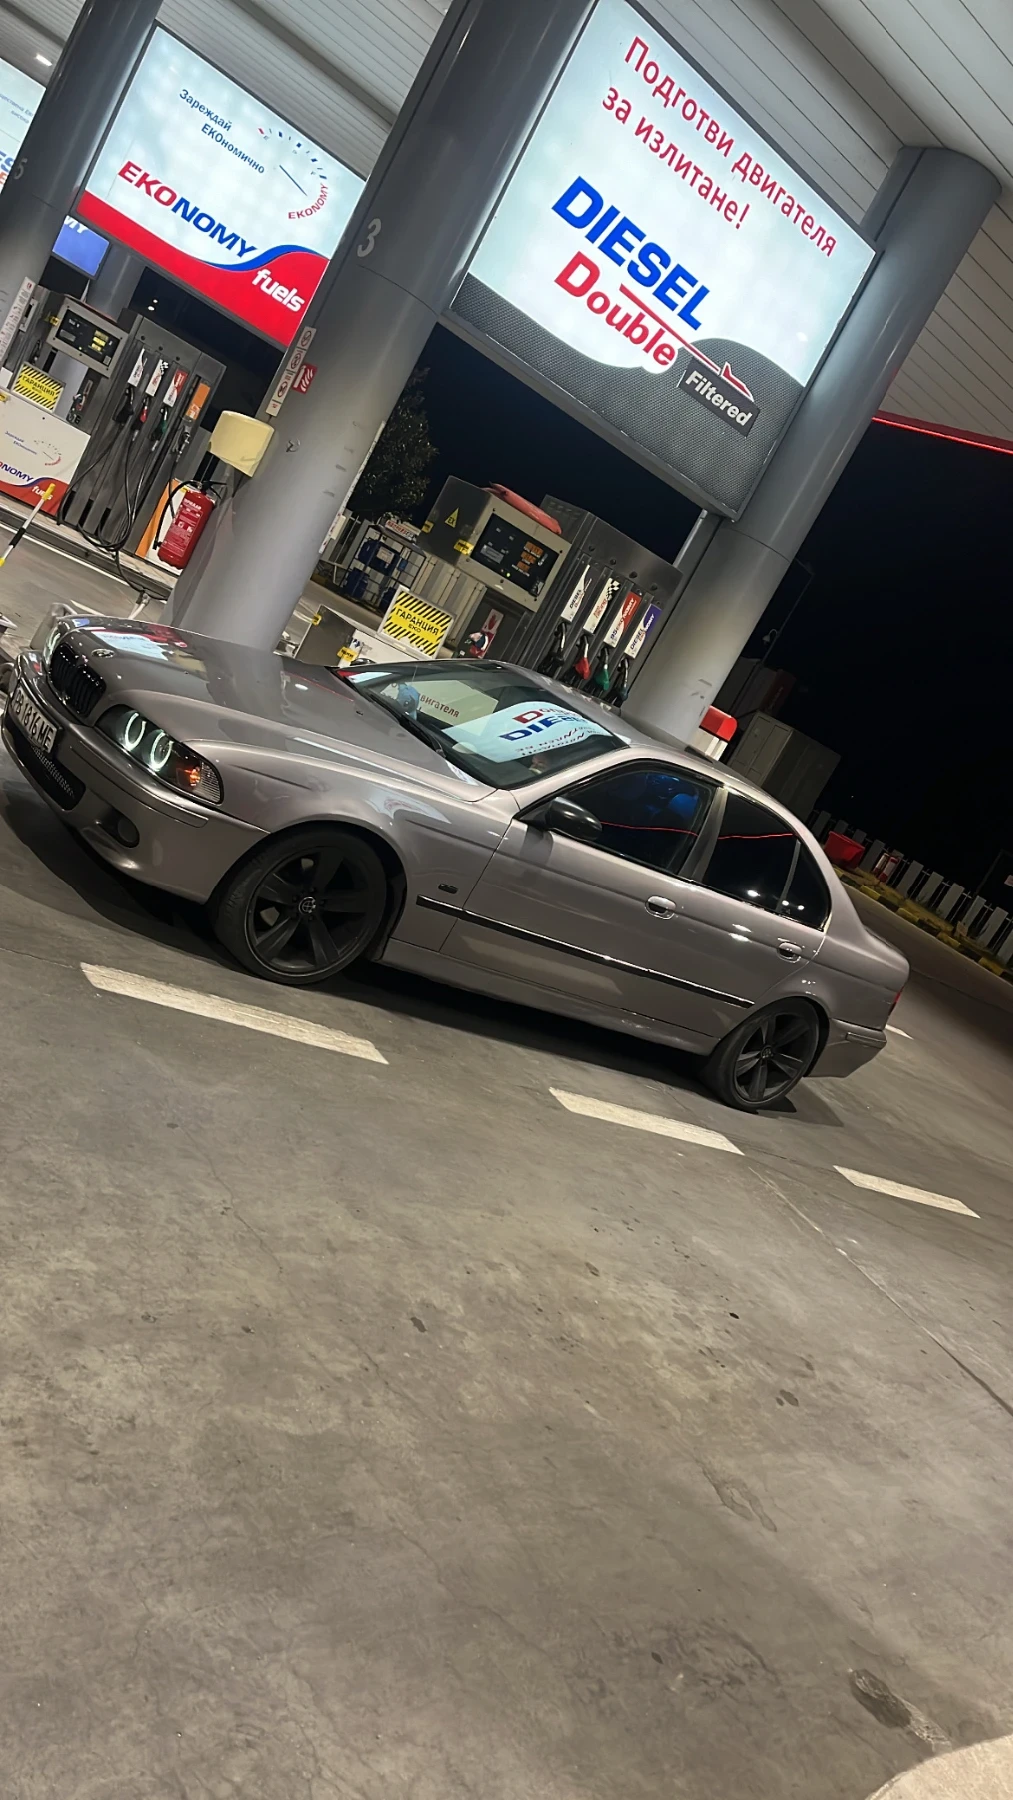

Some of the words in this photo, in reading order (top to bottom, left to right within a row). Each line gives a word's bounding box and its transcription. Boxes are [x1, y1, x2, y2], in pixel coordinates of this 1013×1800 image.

[179, 89, 232, 132] Зареждай
[201, 123, 265, 174] ЕКОномично
[602, 87, 631, 124] за
[635, 117, 750, 229] излитане!
[624, 36, 734, 157] Подготви
[732, 152, 837, 257] двигателя
[118, 160, 257, 258] EKONOMY
[288, 183, 328, 220] EKONOMY
[357, 218, 381, 257] 3
[552, 176, 710, 331] DIESEL
[252, 269, 305, 312] fuels
[554, 251, 677, 366] Double
[685, 371, 752, 426] Filtered
[32, 485, 53, 500] fus
[395, 608, 439, 635] ГАРАНЦИЯ
[21, 703, 41, 739] 1816
[37, 721, 54, 750] ME
